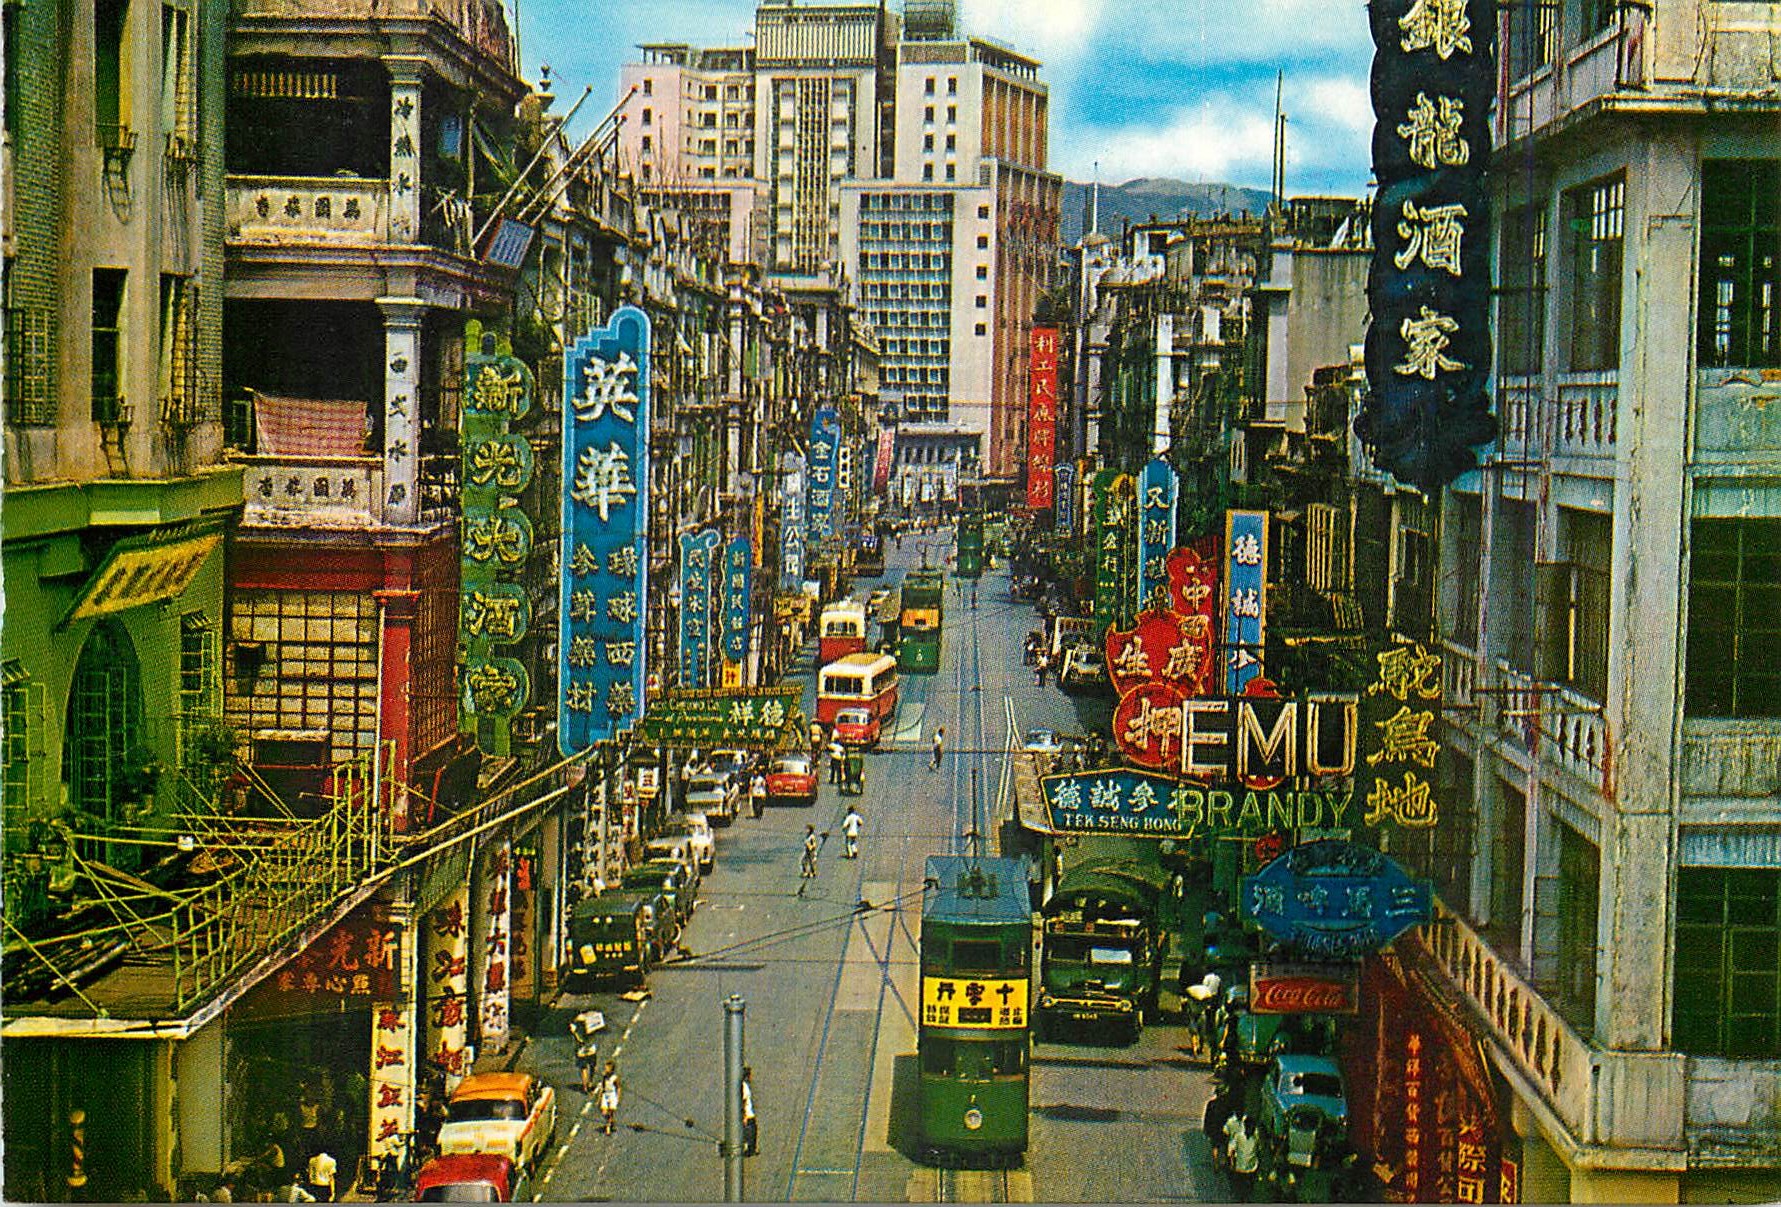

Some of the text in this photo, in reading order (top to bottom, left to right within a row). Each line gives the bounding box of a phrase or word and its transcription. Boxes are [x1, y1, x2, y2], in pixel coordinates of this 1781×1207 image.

[1393, 0, 1473, 380] 銀龍酒家
[571, 350, 639, 522] 英華
[1125, 697, 1182, 757] 押
[1181, 695, 1359, 777] EMU
[1063, 813, 1181, 832] TEK SENG HONG
[1180, 788, 1353, 830] BRANDY
